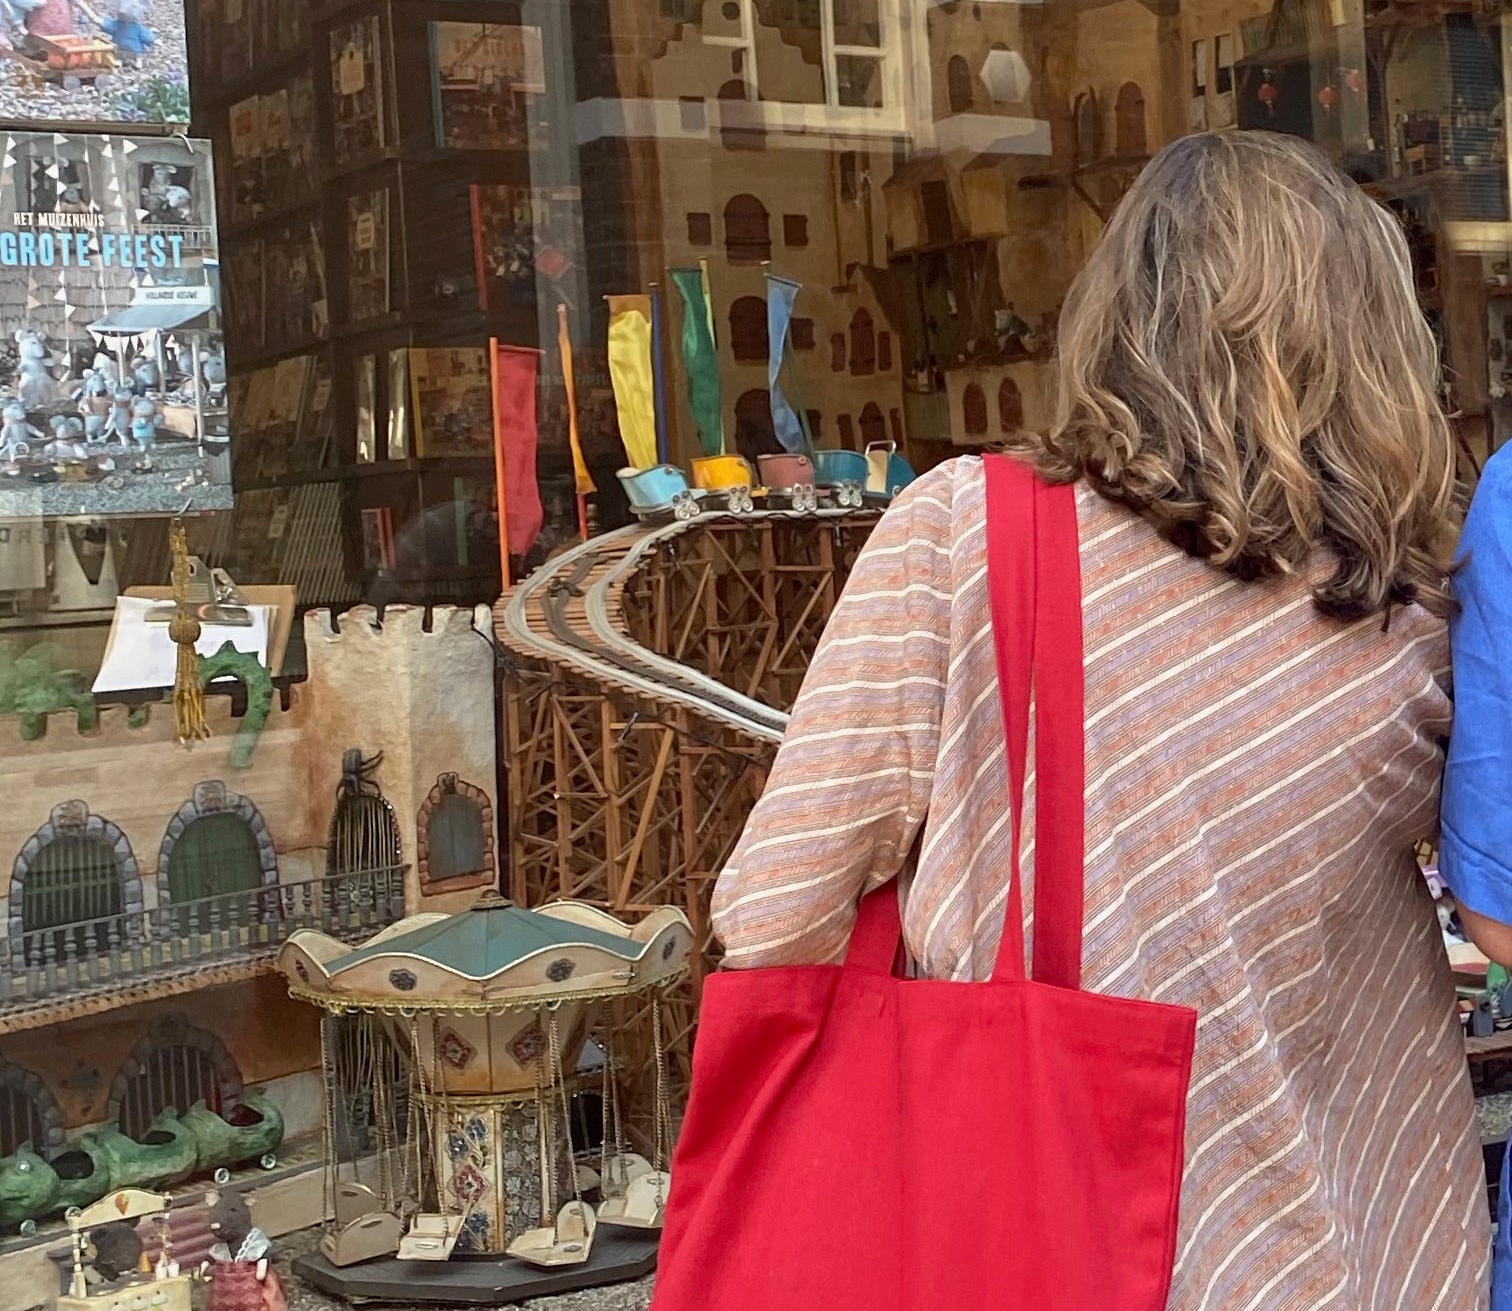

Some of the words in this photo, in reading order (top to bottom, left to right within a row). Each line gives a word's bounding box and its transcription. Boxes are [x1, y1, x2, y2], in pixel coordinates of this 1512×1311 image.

[14, 212, 33, 226] HET
[38, 212, 104, 227] MUIZENHUIS
[0, 231, 91, 267] GROTE
[102, 233, 183, 268] FEEST
